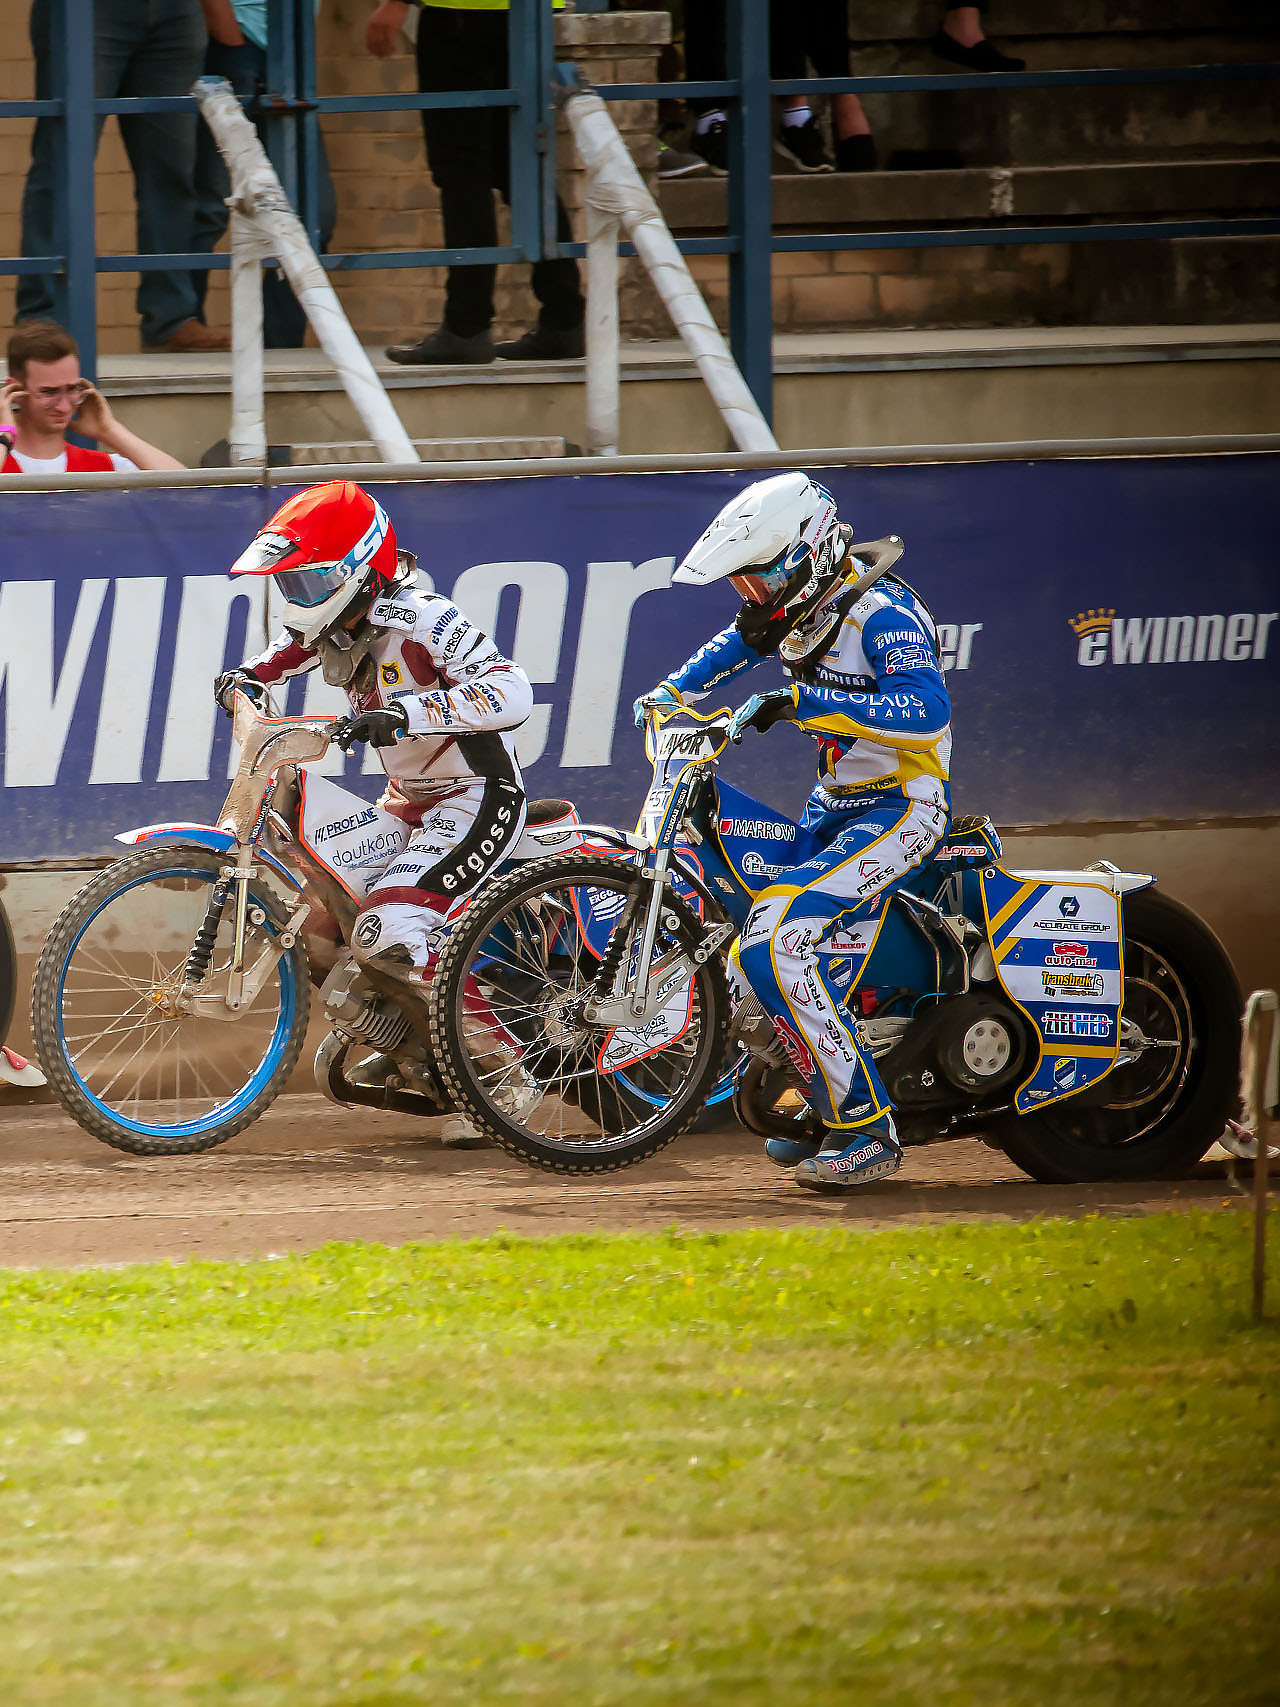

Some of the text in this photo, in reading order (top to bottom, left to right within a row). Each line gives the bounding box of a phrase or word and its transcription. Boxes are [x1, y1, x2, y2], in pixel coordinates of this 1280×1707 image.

[1078, 612, 1280, 667] ewinner
[804, 685, 924, 708] NICOLAUS
[869, 708, 927, 718] BANK
[325, 806, 378, 837] PROFLINE
[734, 819, 796, 842] MARROW
[857, 865, 895, 896] PRES
[1032, 921, 1080, 930] ACCURATE
[1045, 955, 1098, 968] auto-mar
[803, 964, 826, 1012] PRES
[1041, 971, 1093, 988] Transbruk
[825, 1018, 853, 1063] PRES
